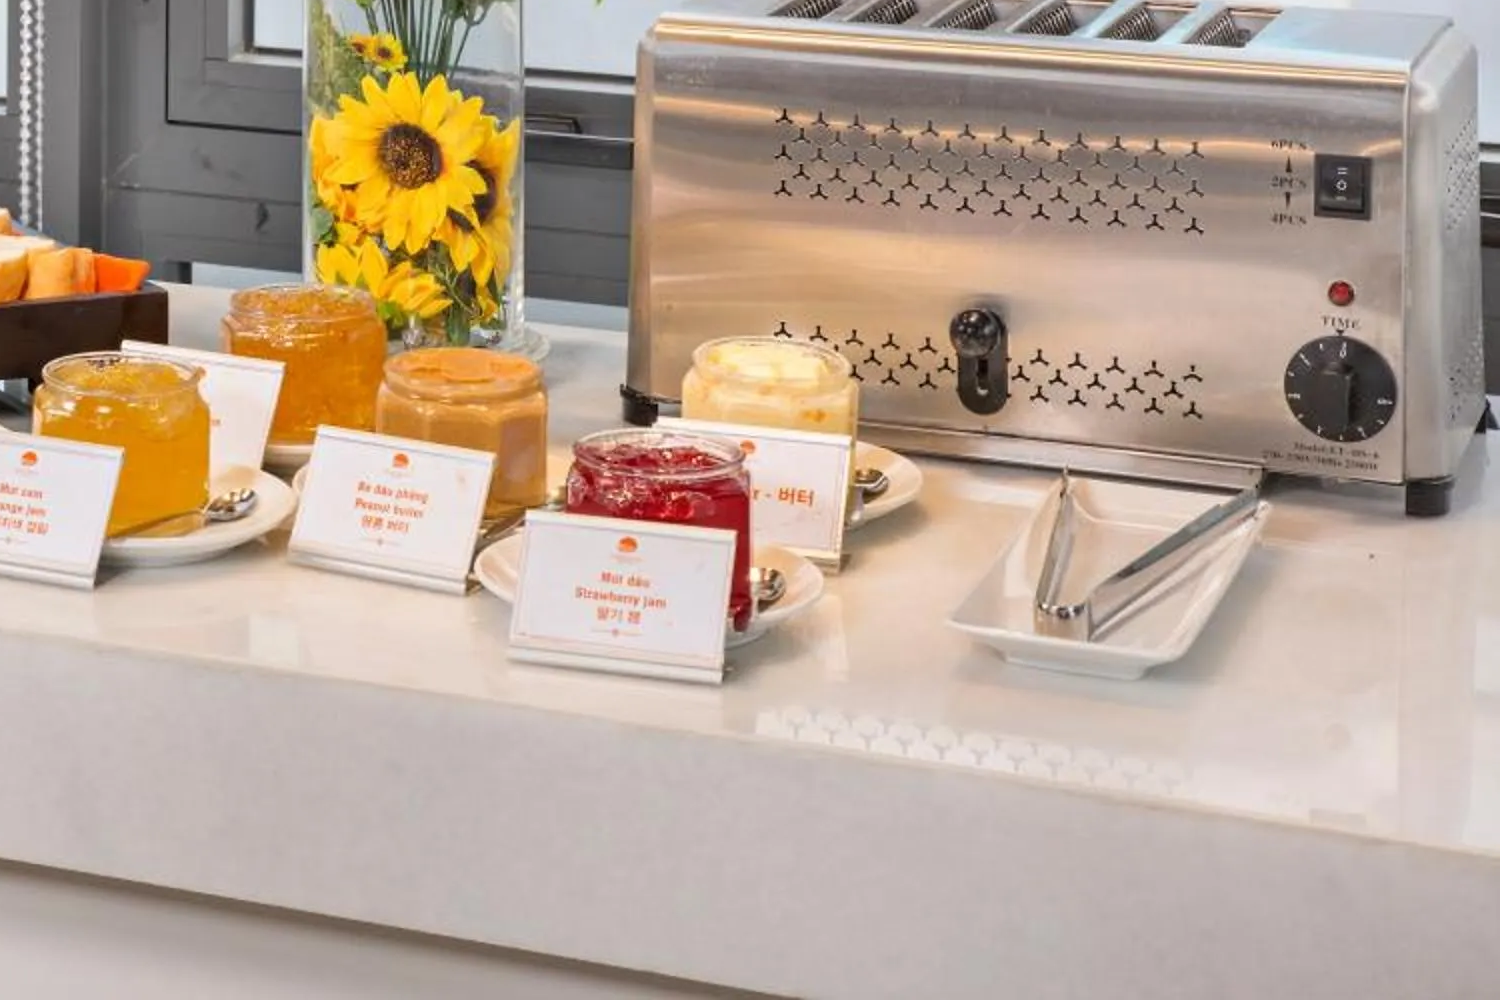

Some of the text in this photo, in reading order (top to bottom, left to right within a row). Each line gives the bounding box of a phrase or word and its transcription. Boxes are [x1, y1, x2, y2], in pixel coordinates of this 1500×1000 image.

[1320, 315, 1362, 330] TIME
[778, 487, 814, 507] 버터
[26, 504, 47, 518] jam
[355, 497, 424, 519] Peanut butter
[575, 586, 667, 610] Strawberry jam
